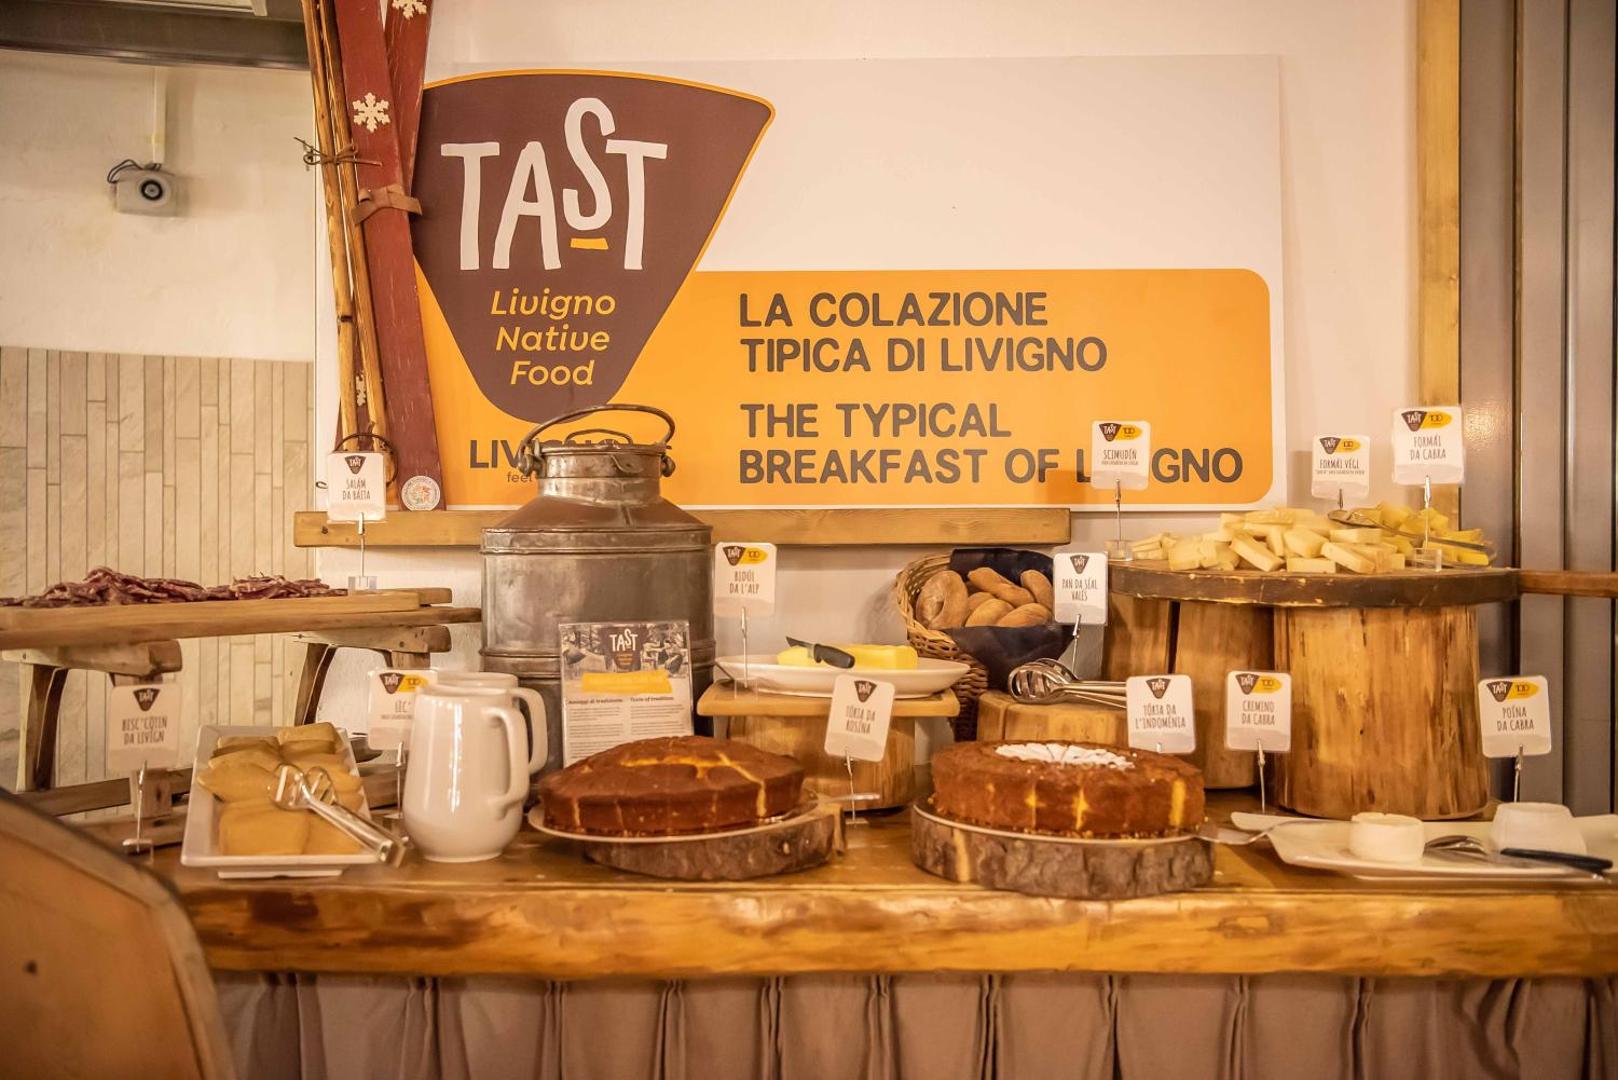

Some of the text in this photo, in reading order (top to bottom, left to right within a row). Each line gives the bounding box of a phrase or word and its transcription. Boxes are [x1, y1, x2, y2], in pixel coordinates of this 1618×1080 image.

[441, 97, 668, 270] TAST
[491, 287, 616, 320] Livigno
[739, 291, 1048, 328] LA COLAZIONE
[496, 323, 610, 352] Native
[739, 336, 1108, 373] TIPICA DI LIVIGNO
[510, 359, 595, 386] Food
[740, 402, 1012, 438] THE TYPICAL
[739, 447, 1244, 484] BREAKFAST OF LGNO
[1409, 448, 1420, 461] DA
[729, 582, 739, 594] DA
[609, 628, 638, 652] TAST
[1165, 704, 1177, 716] DA
[1241, 712, 1251, 725] DA
[1496, 720, 1508, 731] DA
